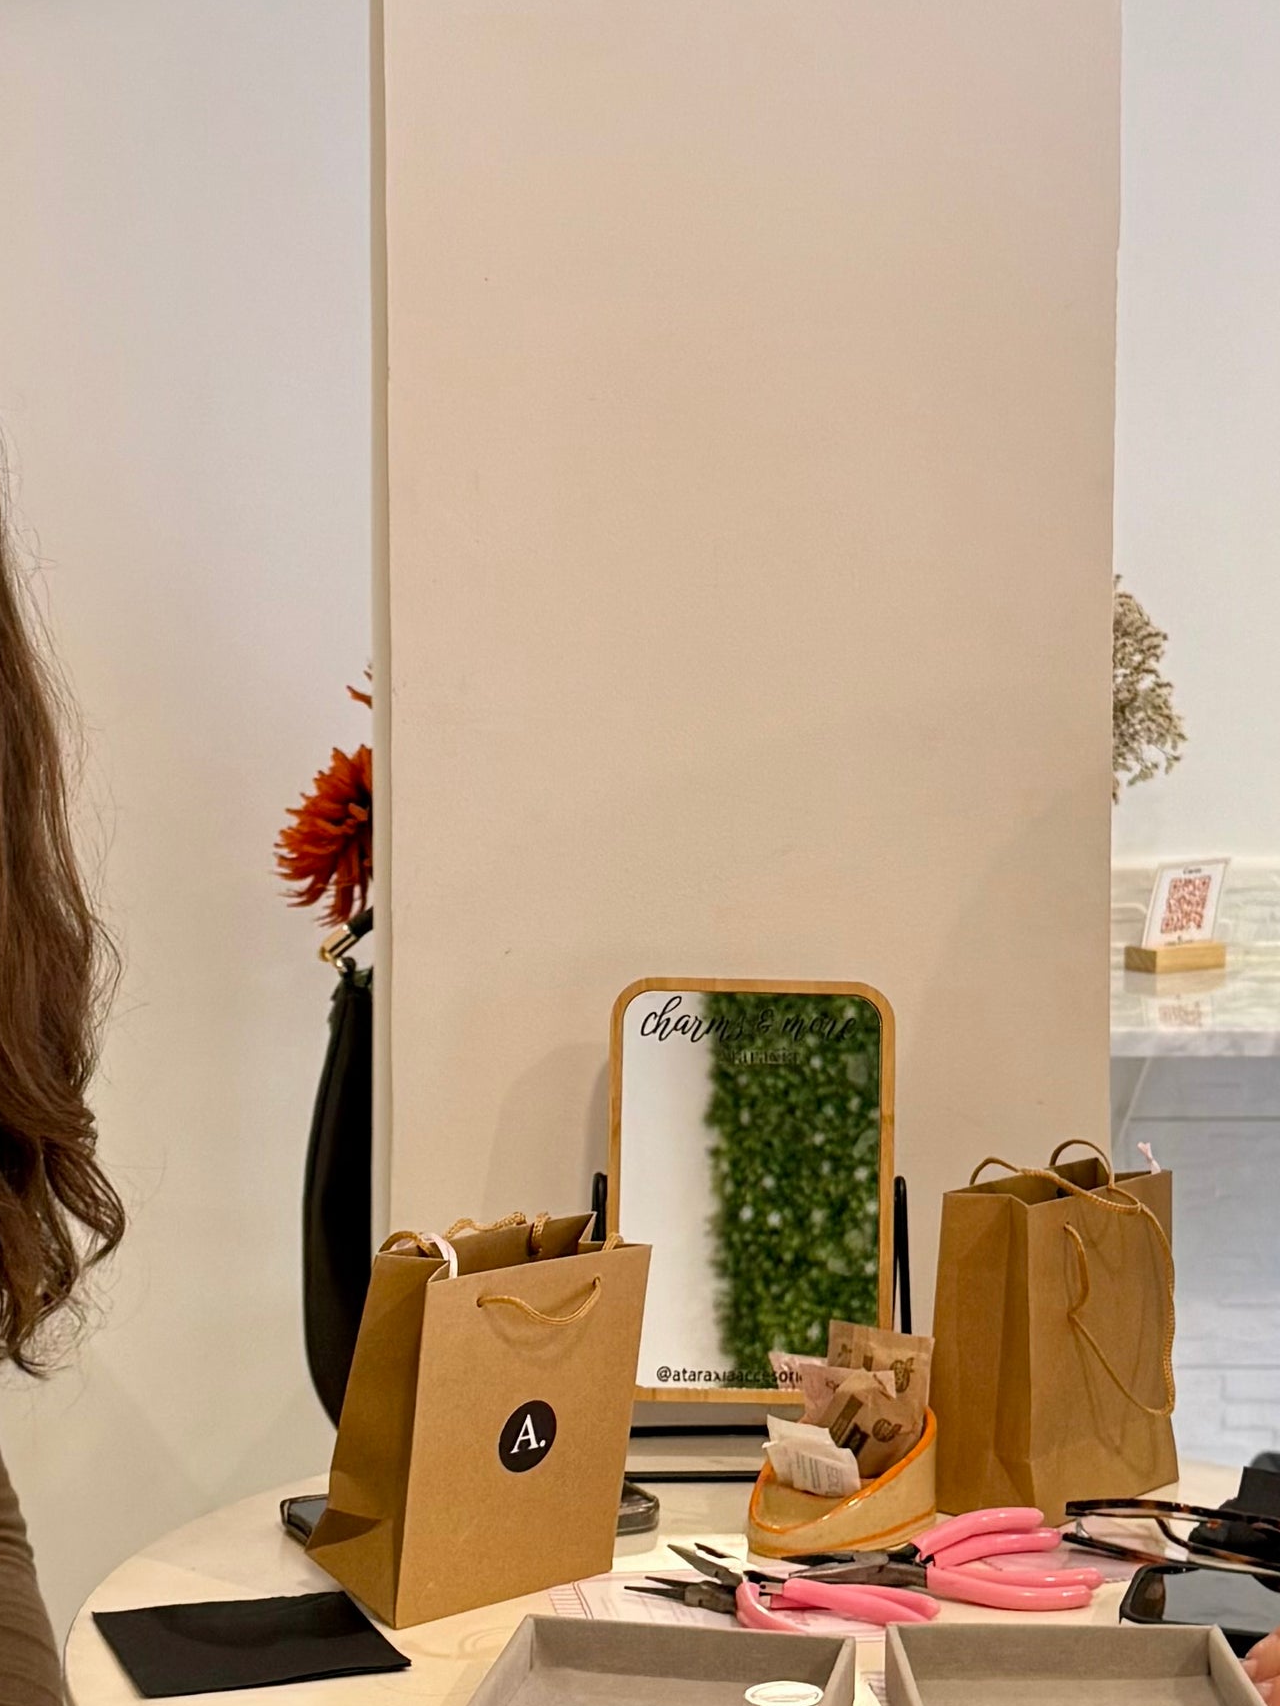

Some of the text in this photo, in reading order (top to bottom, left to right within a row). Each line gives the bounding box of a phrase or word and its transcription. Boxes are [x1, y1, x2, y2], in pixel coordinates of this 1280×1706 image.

[640, 995, 745, 1043] charms
[781, 1015, 858, 1042] more
[510, 1413, 546, 1454] A.
